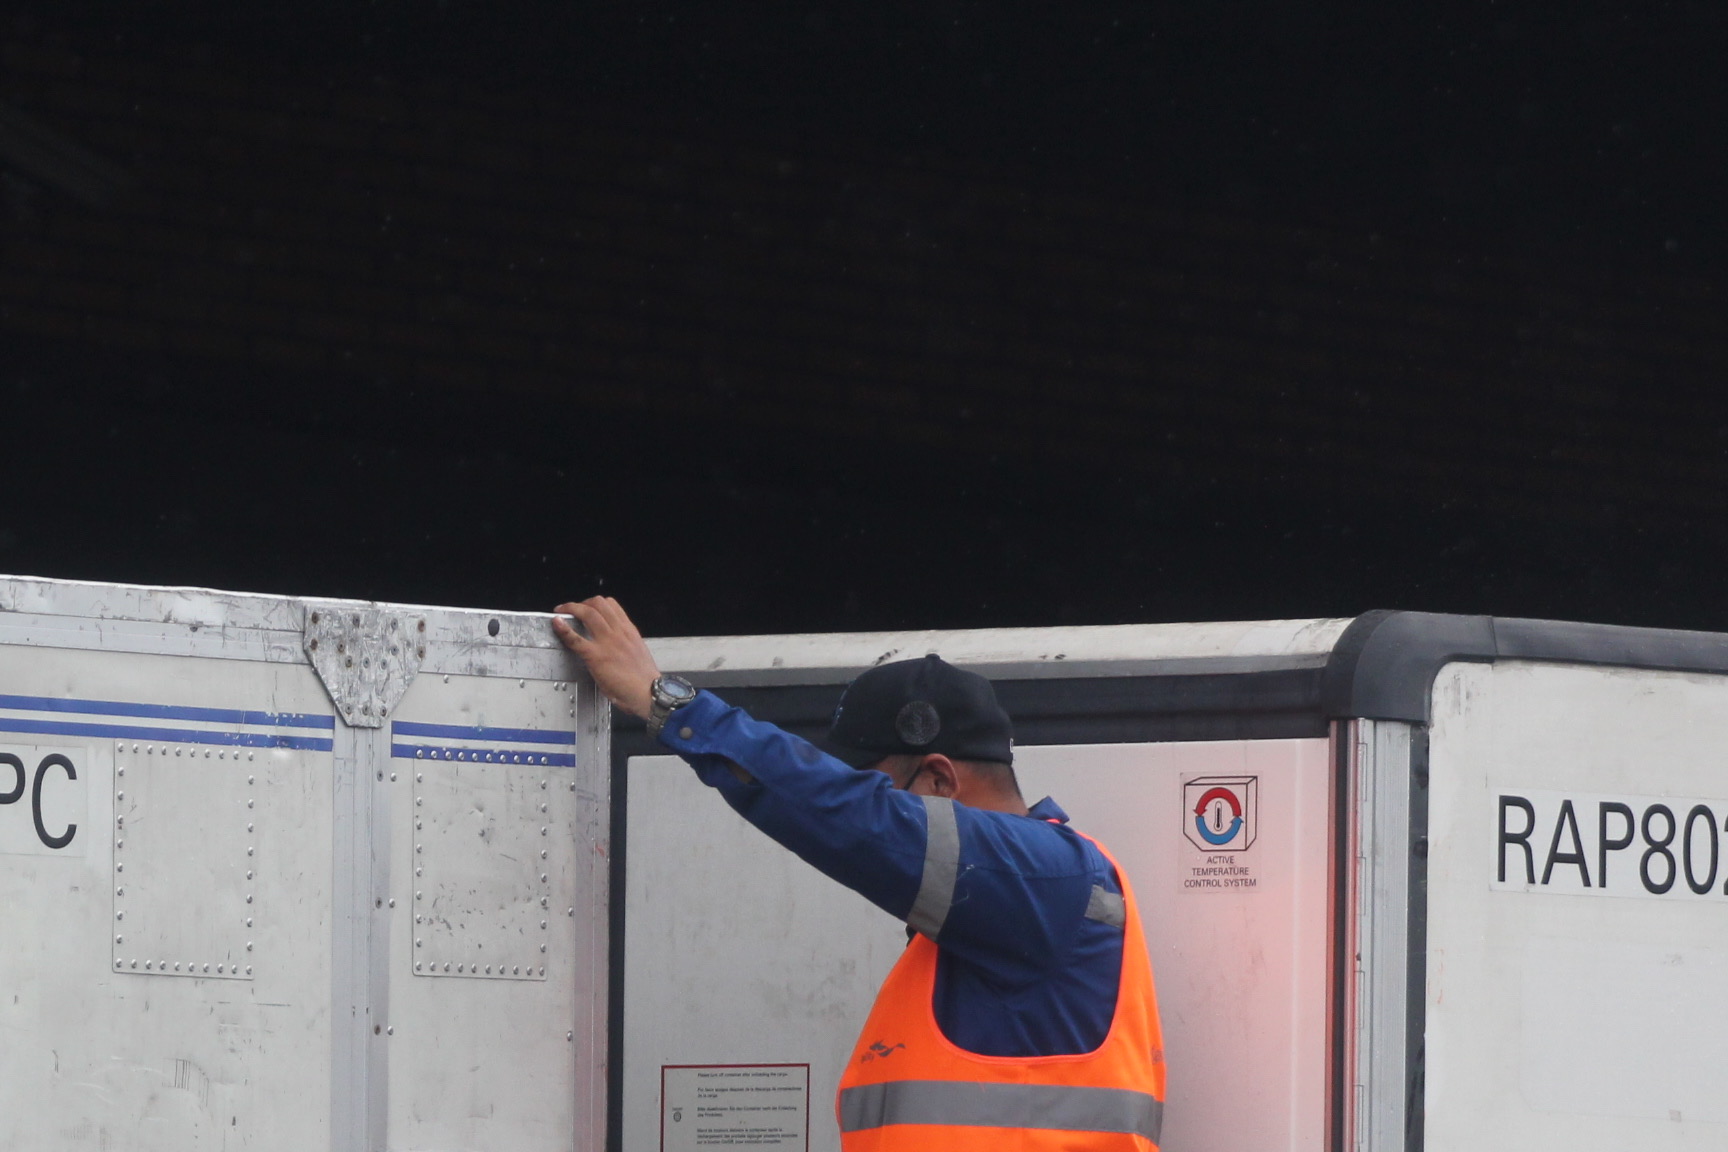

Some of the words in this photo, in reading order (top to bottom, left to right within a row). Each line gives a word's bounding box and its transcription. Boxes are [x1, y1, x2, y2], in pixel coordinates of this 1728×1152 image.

[1497, 794, 1728, 896] RAP80
[1206, 855, 1235, 865] ACTIVE
[1191, 866, 1250, 877] TEMPERATURE
[1184, 879, 1222, 888] CONTROL
[1223, 878, 1257, 887] SYSTEM
